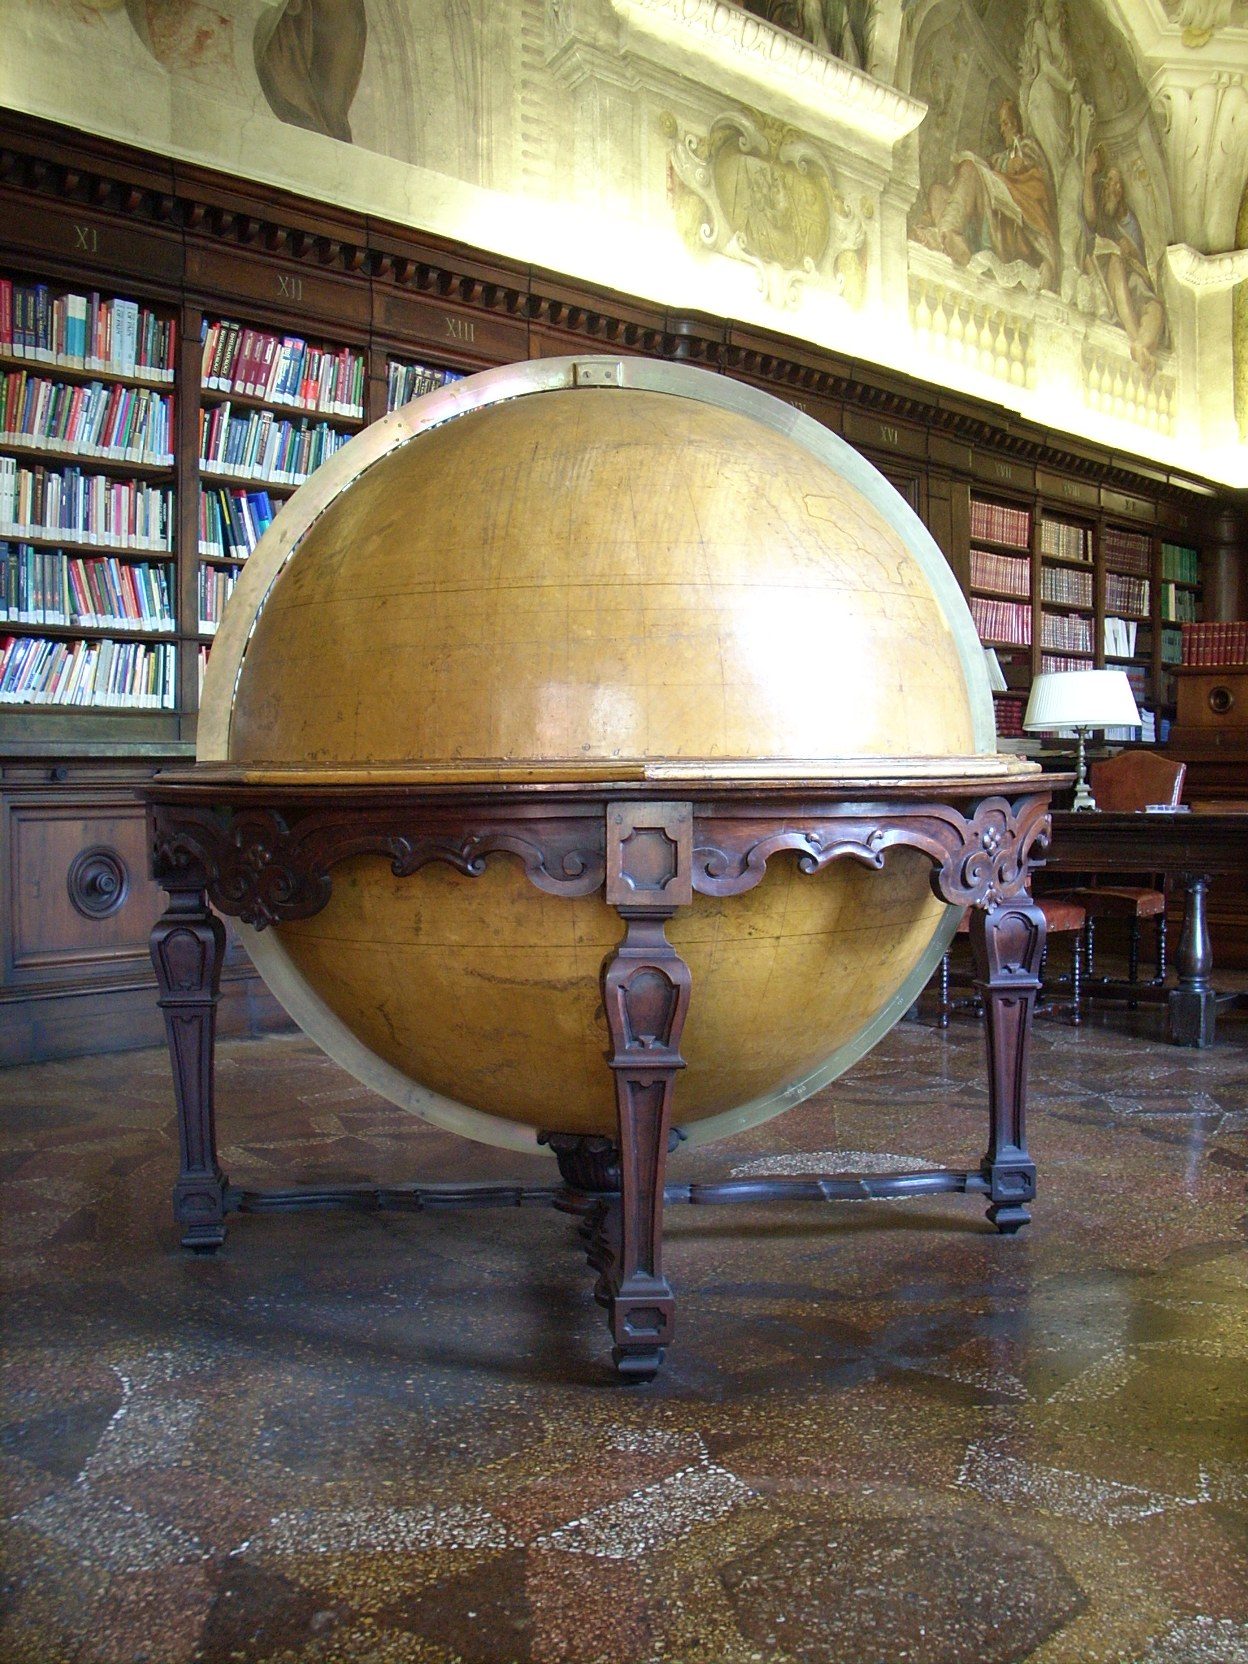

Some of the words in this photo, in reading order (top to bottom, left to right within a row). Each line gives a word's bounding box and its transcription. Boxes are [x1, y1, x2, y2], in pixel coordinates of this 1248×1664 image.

[73, 224, 97, 252] XI
[276, 274, 302, 301] XII
[445, 317, 474, 342] XIII
[880, 425, 898, 445] XVI
